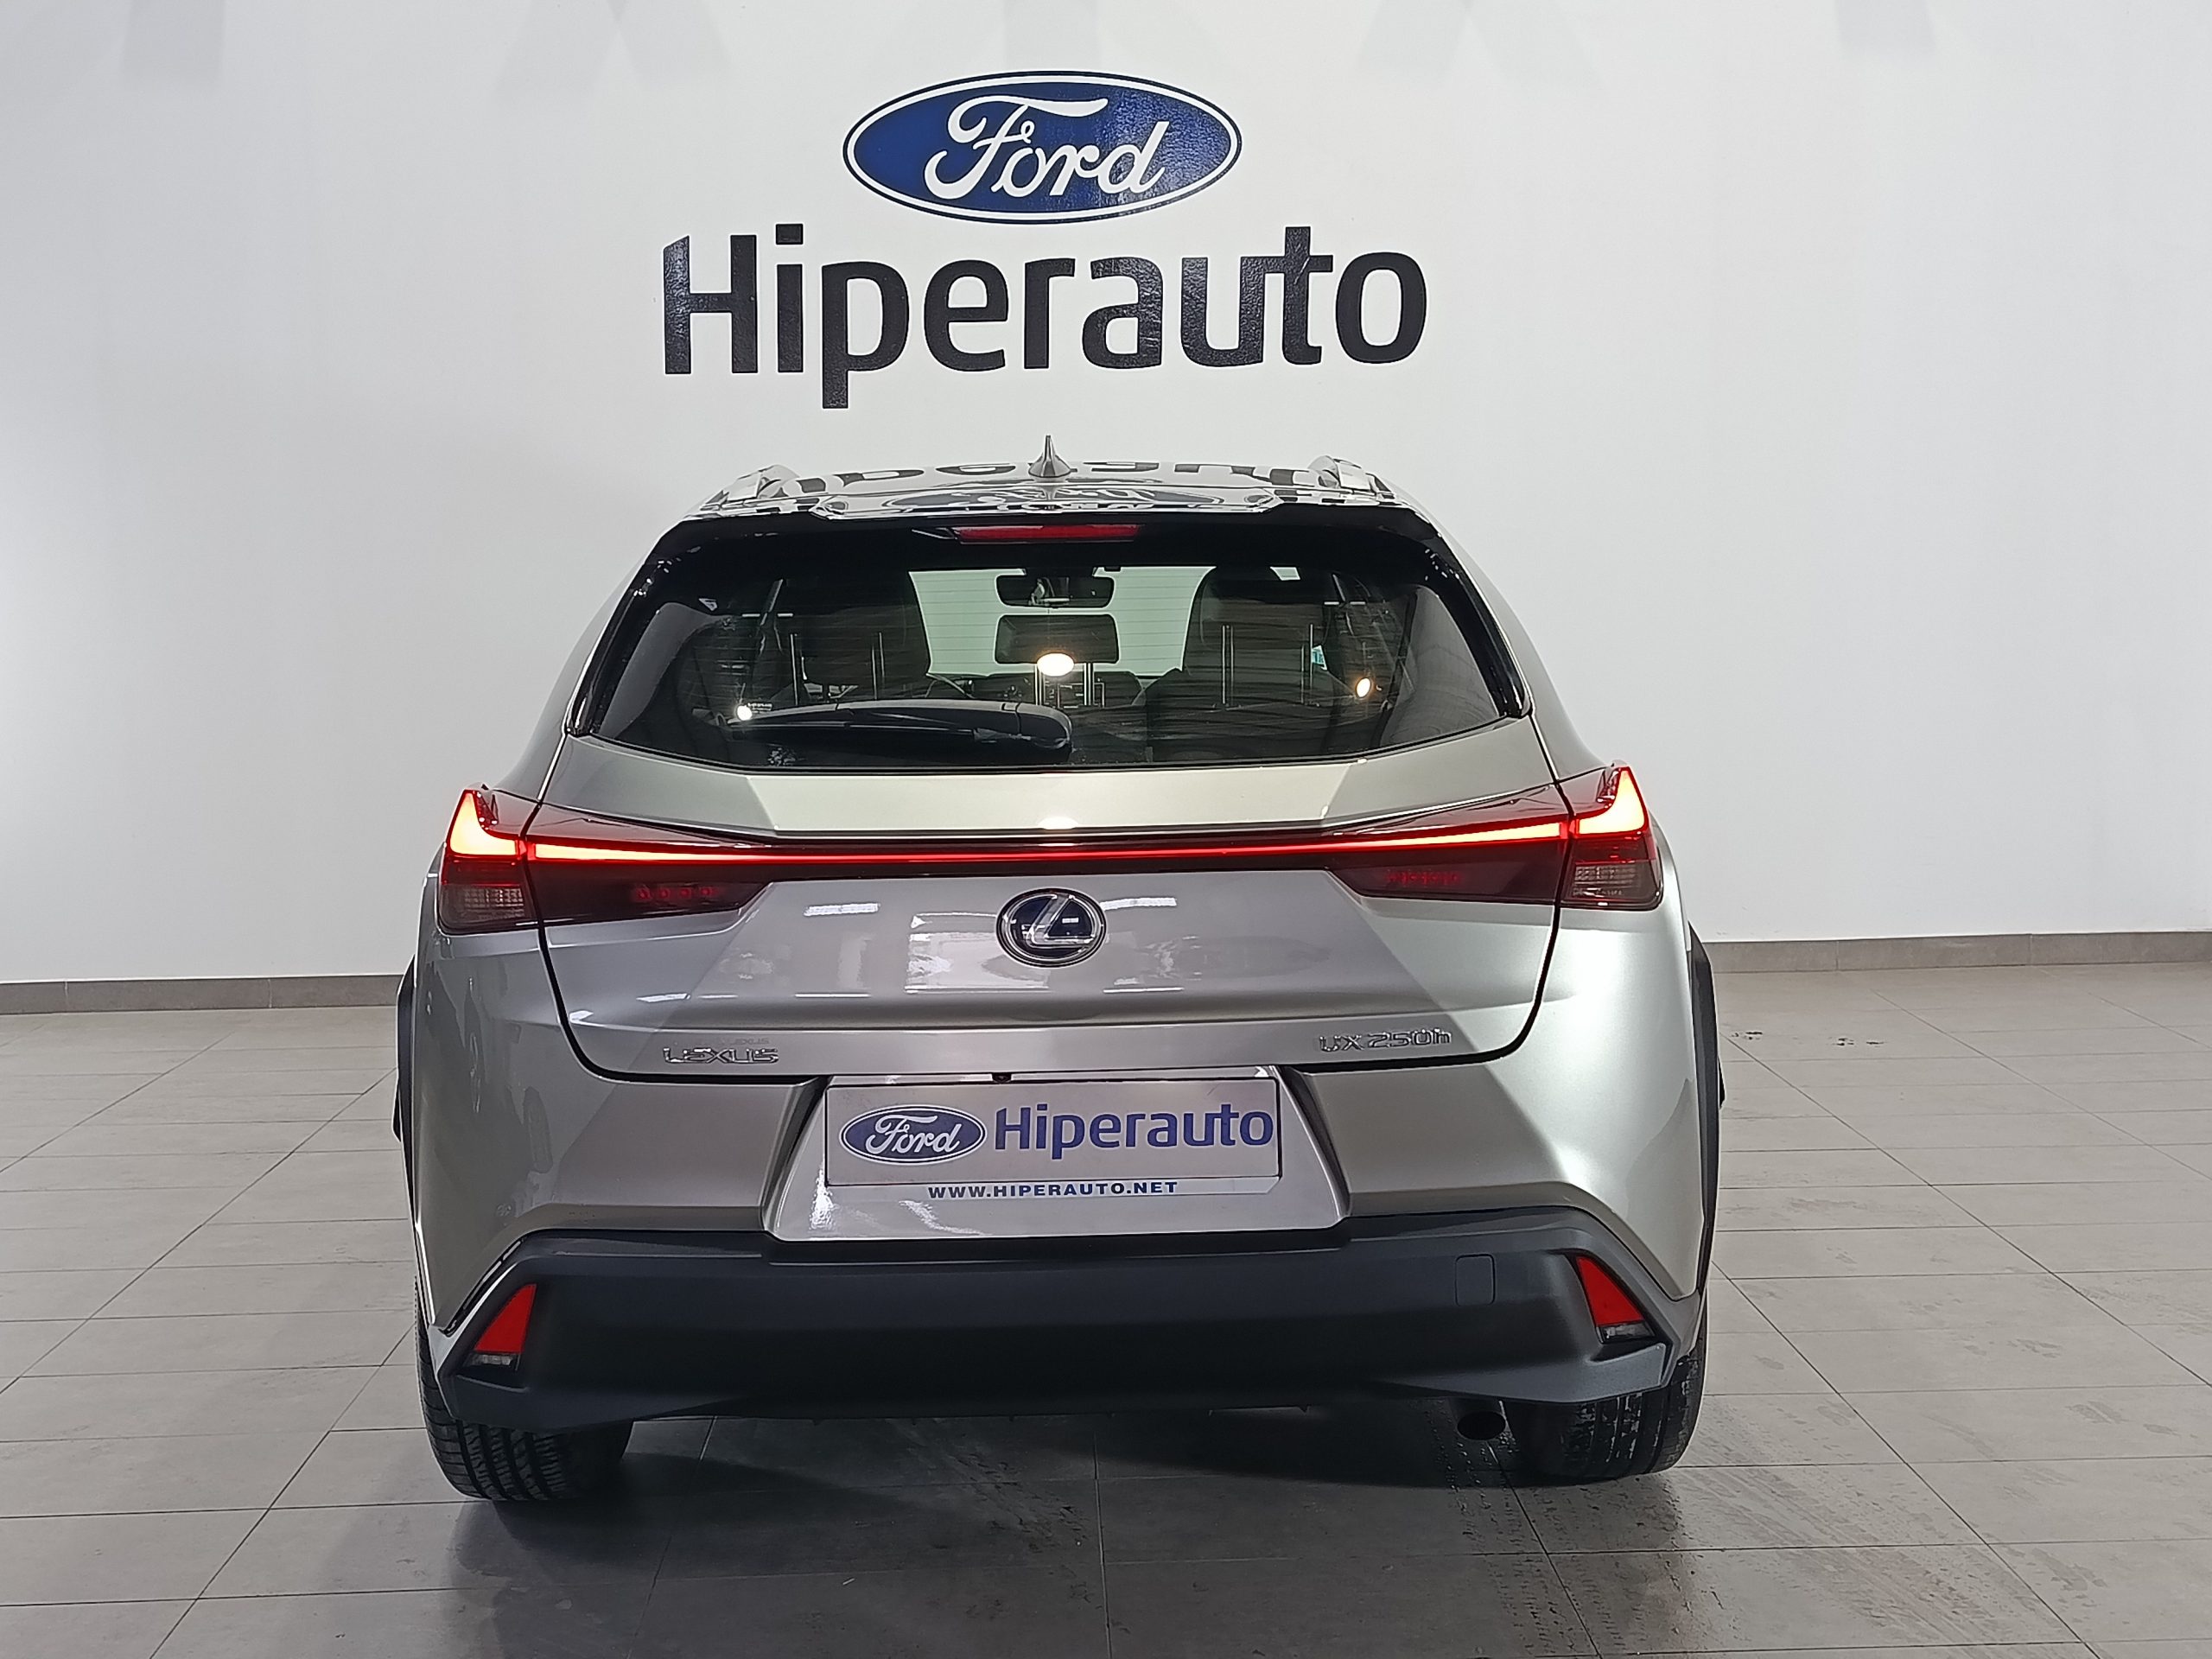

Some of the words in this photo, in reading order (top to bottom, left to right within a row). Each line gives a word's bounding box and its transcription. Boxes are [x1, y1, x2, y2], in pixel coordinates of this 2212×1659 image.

[924, 95, 1169, 198] Ford
[663, 223, 1427, 409] Hiperauto
[663, 1047, 779, 1064] LEXUS
[1319, 1035, 1364, 1052] UX
[1367, 1028, 1452, 1048] 250h
[863, 1115, 960, 1154] Ford
[995, 1103, 1274, 1160] Hiperauto
[928, 1181, 1178, 1198] WWW.HIPERAUTO.NET
